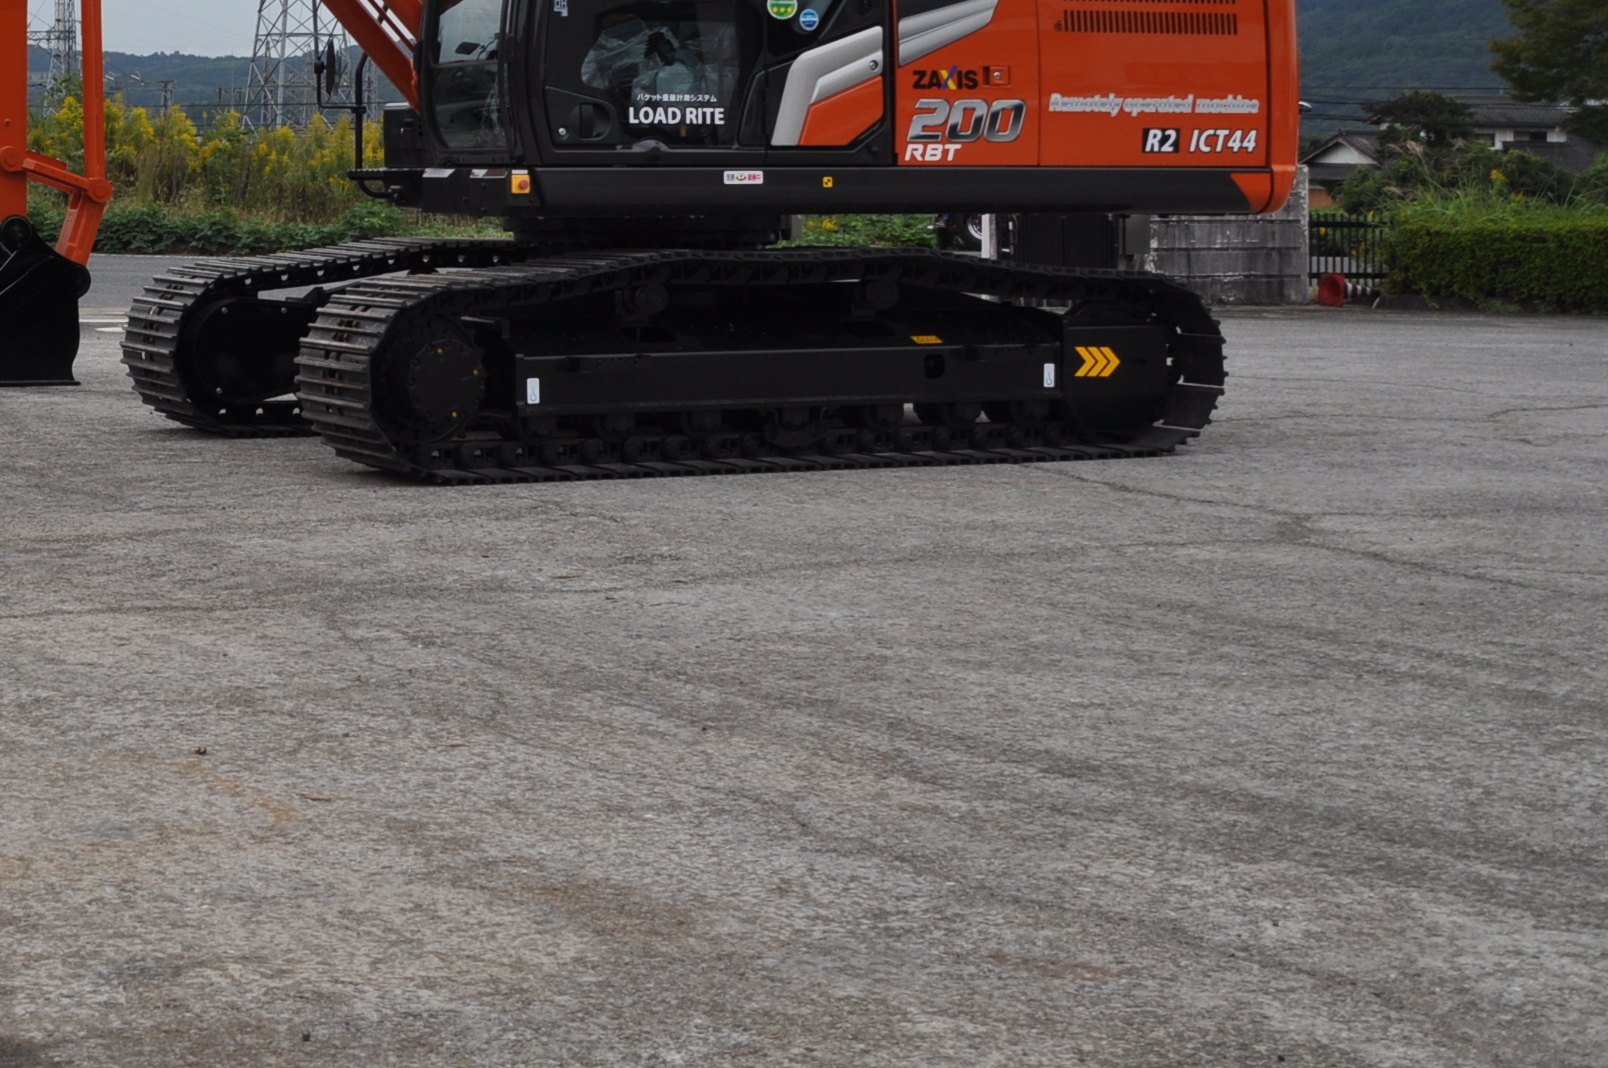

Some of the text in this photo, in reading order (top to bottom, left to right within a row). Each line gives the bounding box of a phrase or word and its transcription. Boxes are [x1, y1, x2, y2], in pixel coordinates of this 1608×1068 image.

[912, 65, 979, 90] ZAXIS
[628, 106, 725, 125] LOAD RITE
[1048, 92, 1260, 118] Remotely operated machine
[906, 98, 1027, 143] 200
[904, 143, 962, 162] RBT
[1144, 128, 1259, 153] R2 ICT44
